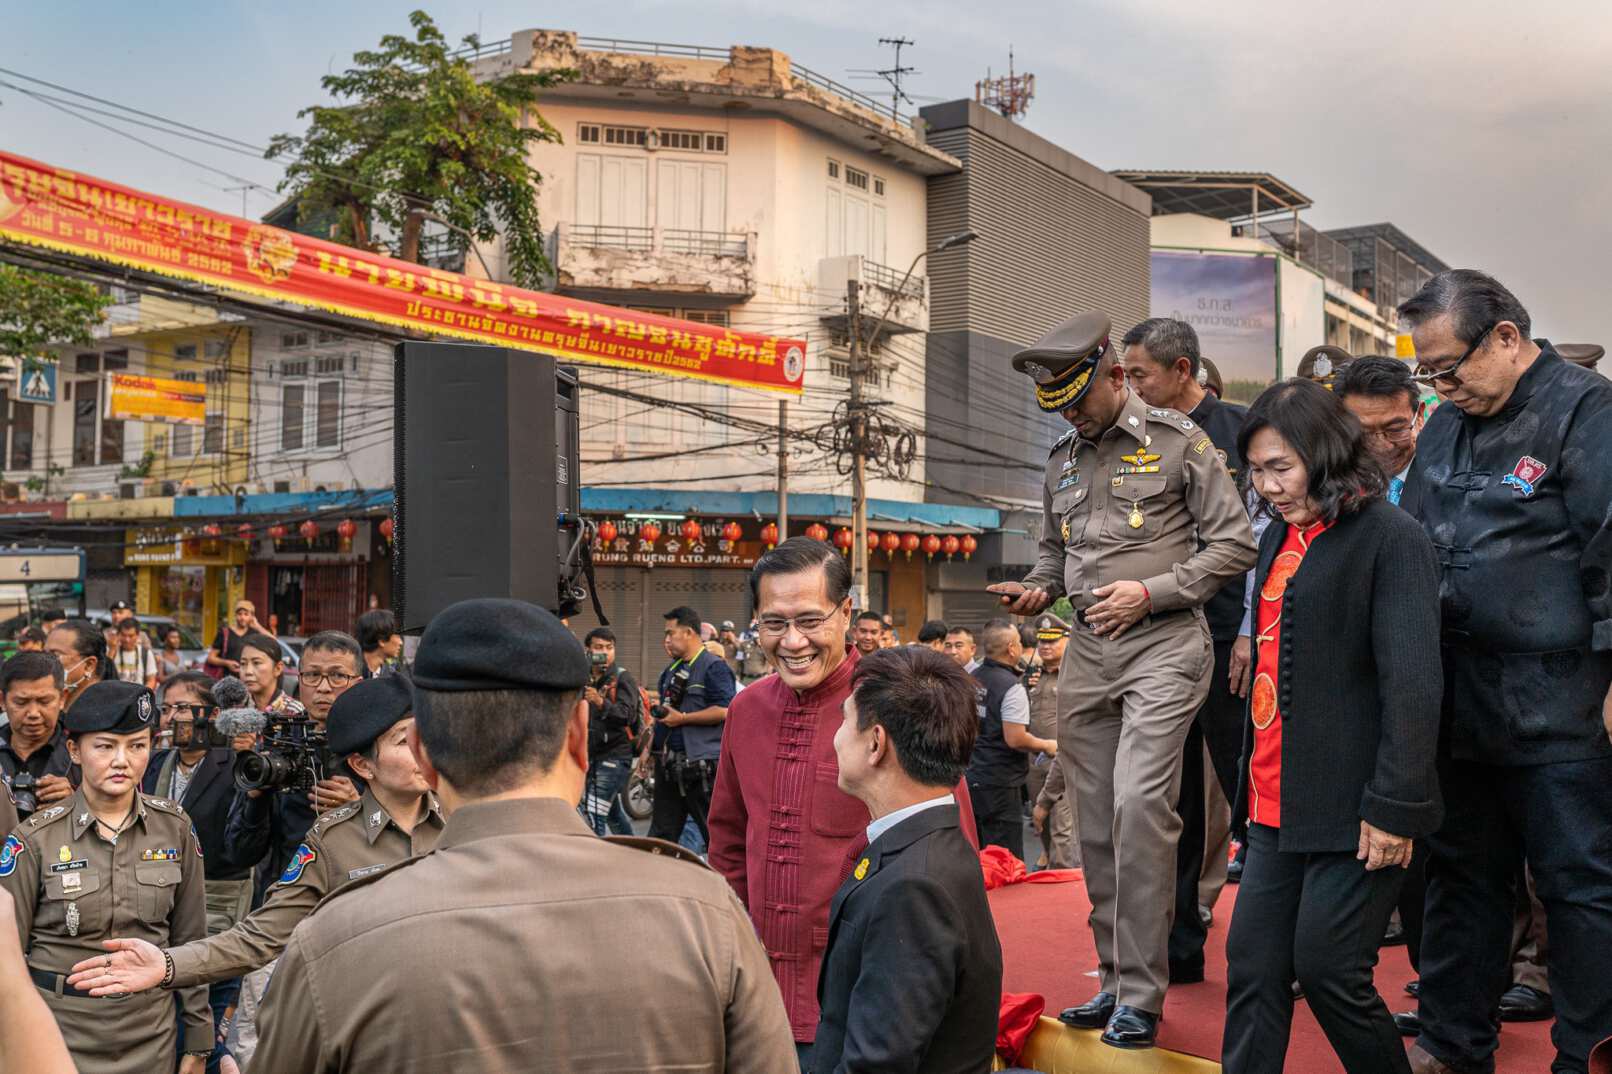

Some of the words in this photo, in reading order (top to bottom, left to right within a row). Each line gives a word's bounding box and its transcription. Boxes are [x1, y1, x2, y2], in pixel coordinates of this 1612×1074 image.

[113, 375, 157, 390] Kodak
[592, 553, 629, 563] RUNG
[633, 553, 677, 564] RUENG
[20, 560, 31, 577] 4
